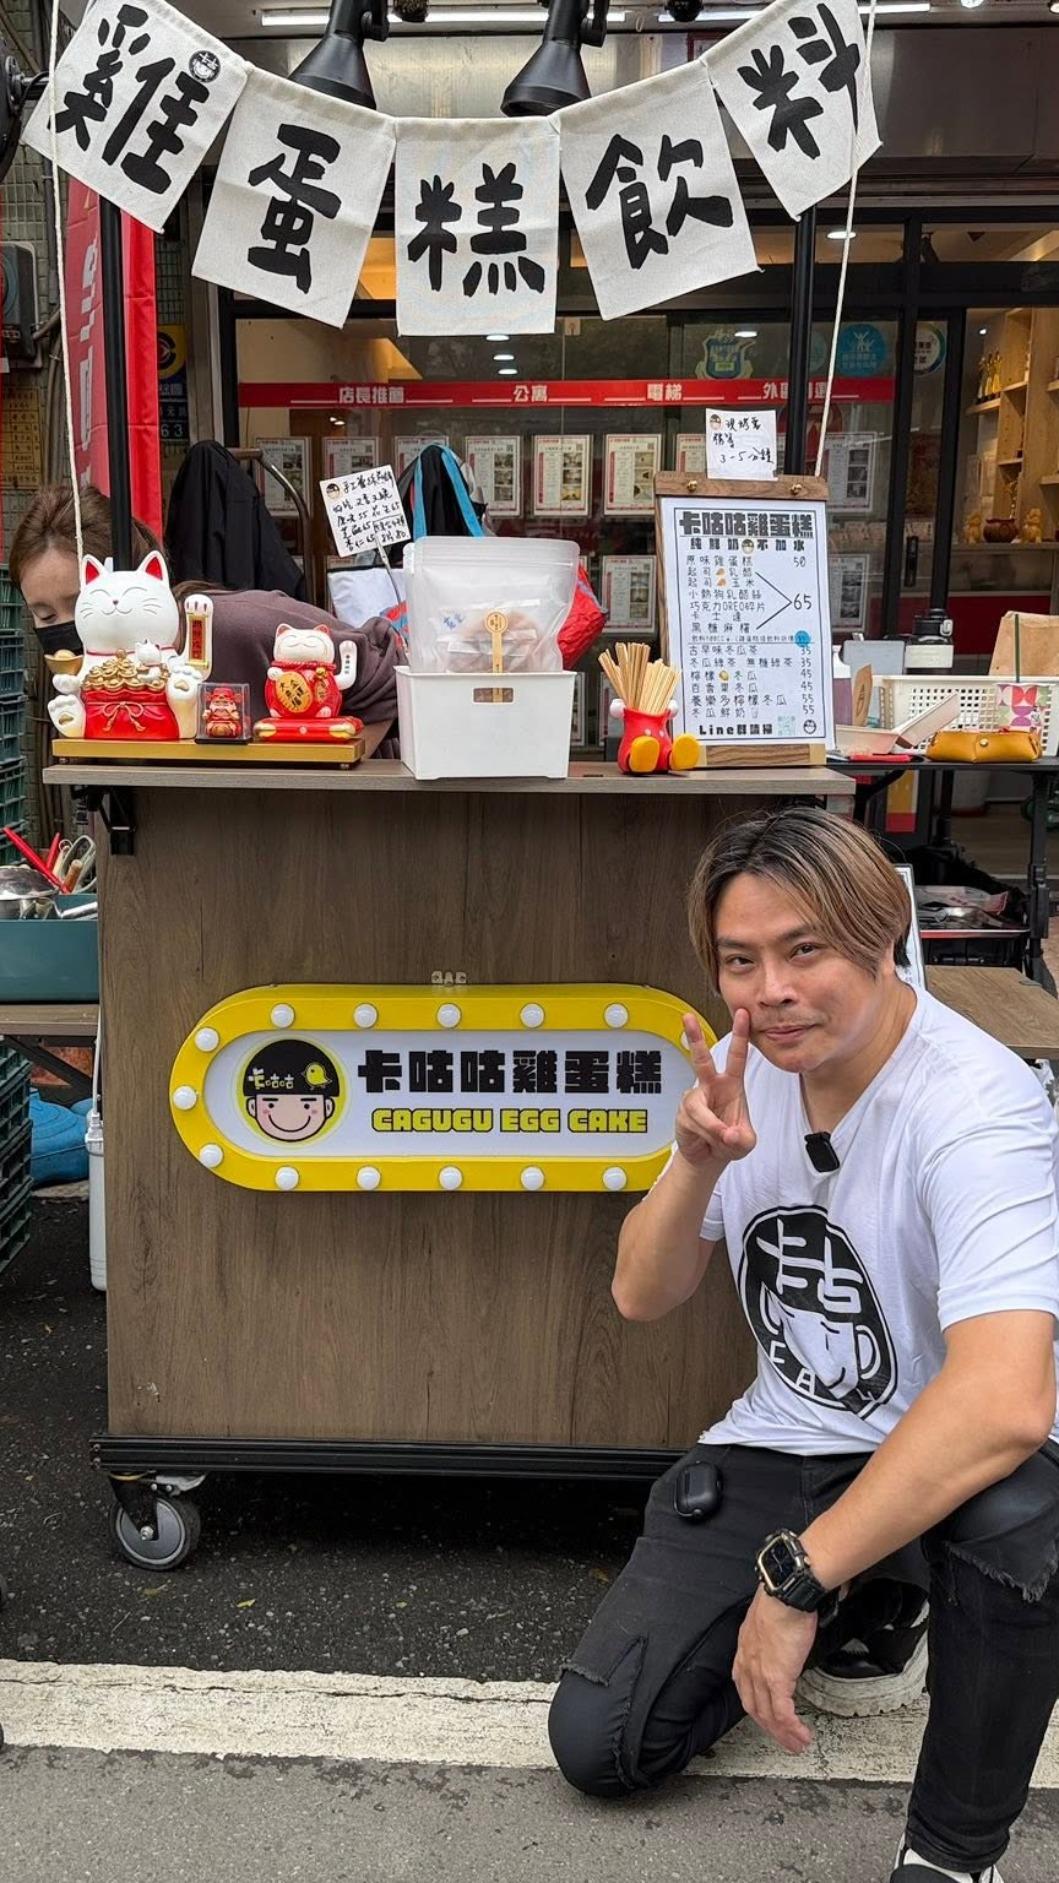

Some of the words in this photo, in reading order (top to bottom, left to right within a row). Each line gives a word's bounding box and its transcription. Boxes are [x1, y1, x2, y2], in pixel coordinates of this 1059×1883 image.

[339, 386, 404, 404] 店長推薦
[513, 384, 548, 402] 公寓
[647, 383, 682, 401] 電梯
[680, 511, 814, 539] 卡咕咕雞蛋糕
[757, 538, 805, 551] 不加水
[686, 555, 753, 567] 原味雞蛋糕
[793, 557, 807, 567] 50
[688, 567, 711, 576] 起司
[688, 577, 712, 587] 起司
[731, 578, 755, 588] 玉米
[793, 593, 813, 610] 65
[691, 611, 742, 622] 卡士達
[689, 645, 758, 656] 古早味冬瓜茶
[800, 646, 812, 655] 35
[800, 658, 812, 668] 35
[690, 671, 715, 681] 檸檬
[734, 671, 757, 681] 冬瓜
[800, 669, 813, 679] 45
[691, 683, 758, 694] 百香果冬瓜
[801, 681, 814, 691] 45
[691, 694, 787, 706] 養樂多檸檬冬瓜
[802, 693, 814, 704] 55
[691, 707, 746, 718] 冬瓜鮮奶
[802, 704, 815, 715] 55
[248, 1067, 295, 1090] 卡咕咕
[358, 1050, 662, 1094] 卡咕咕雞蛋糕
[371, 1107, 494, 1133] CAGUGU
[500, 1108, 561, 1133] EGG
[567, 1107, 648, 1133] CAKE
